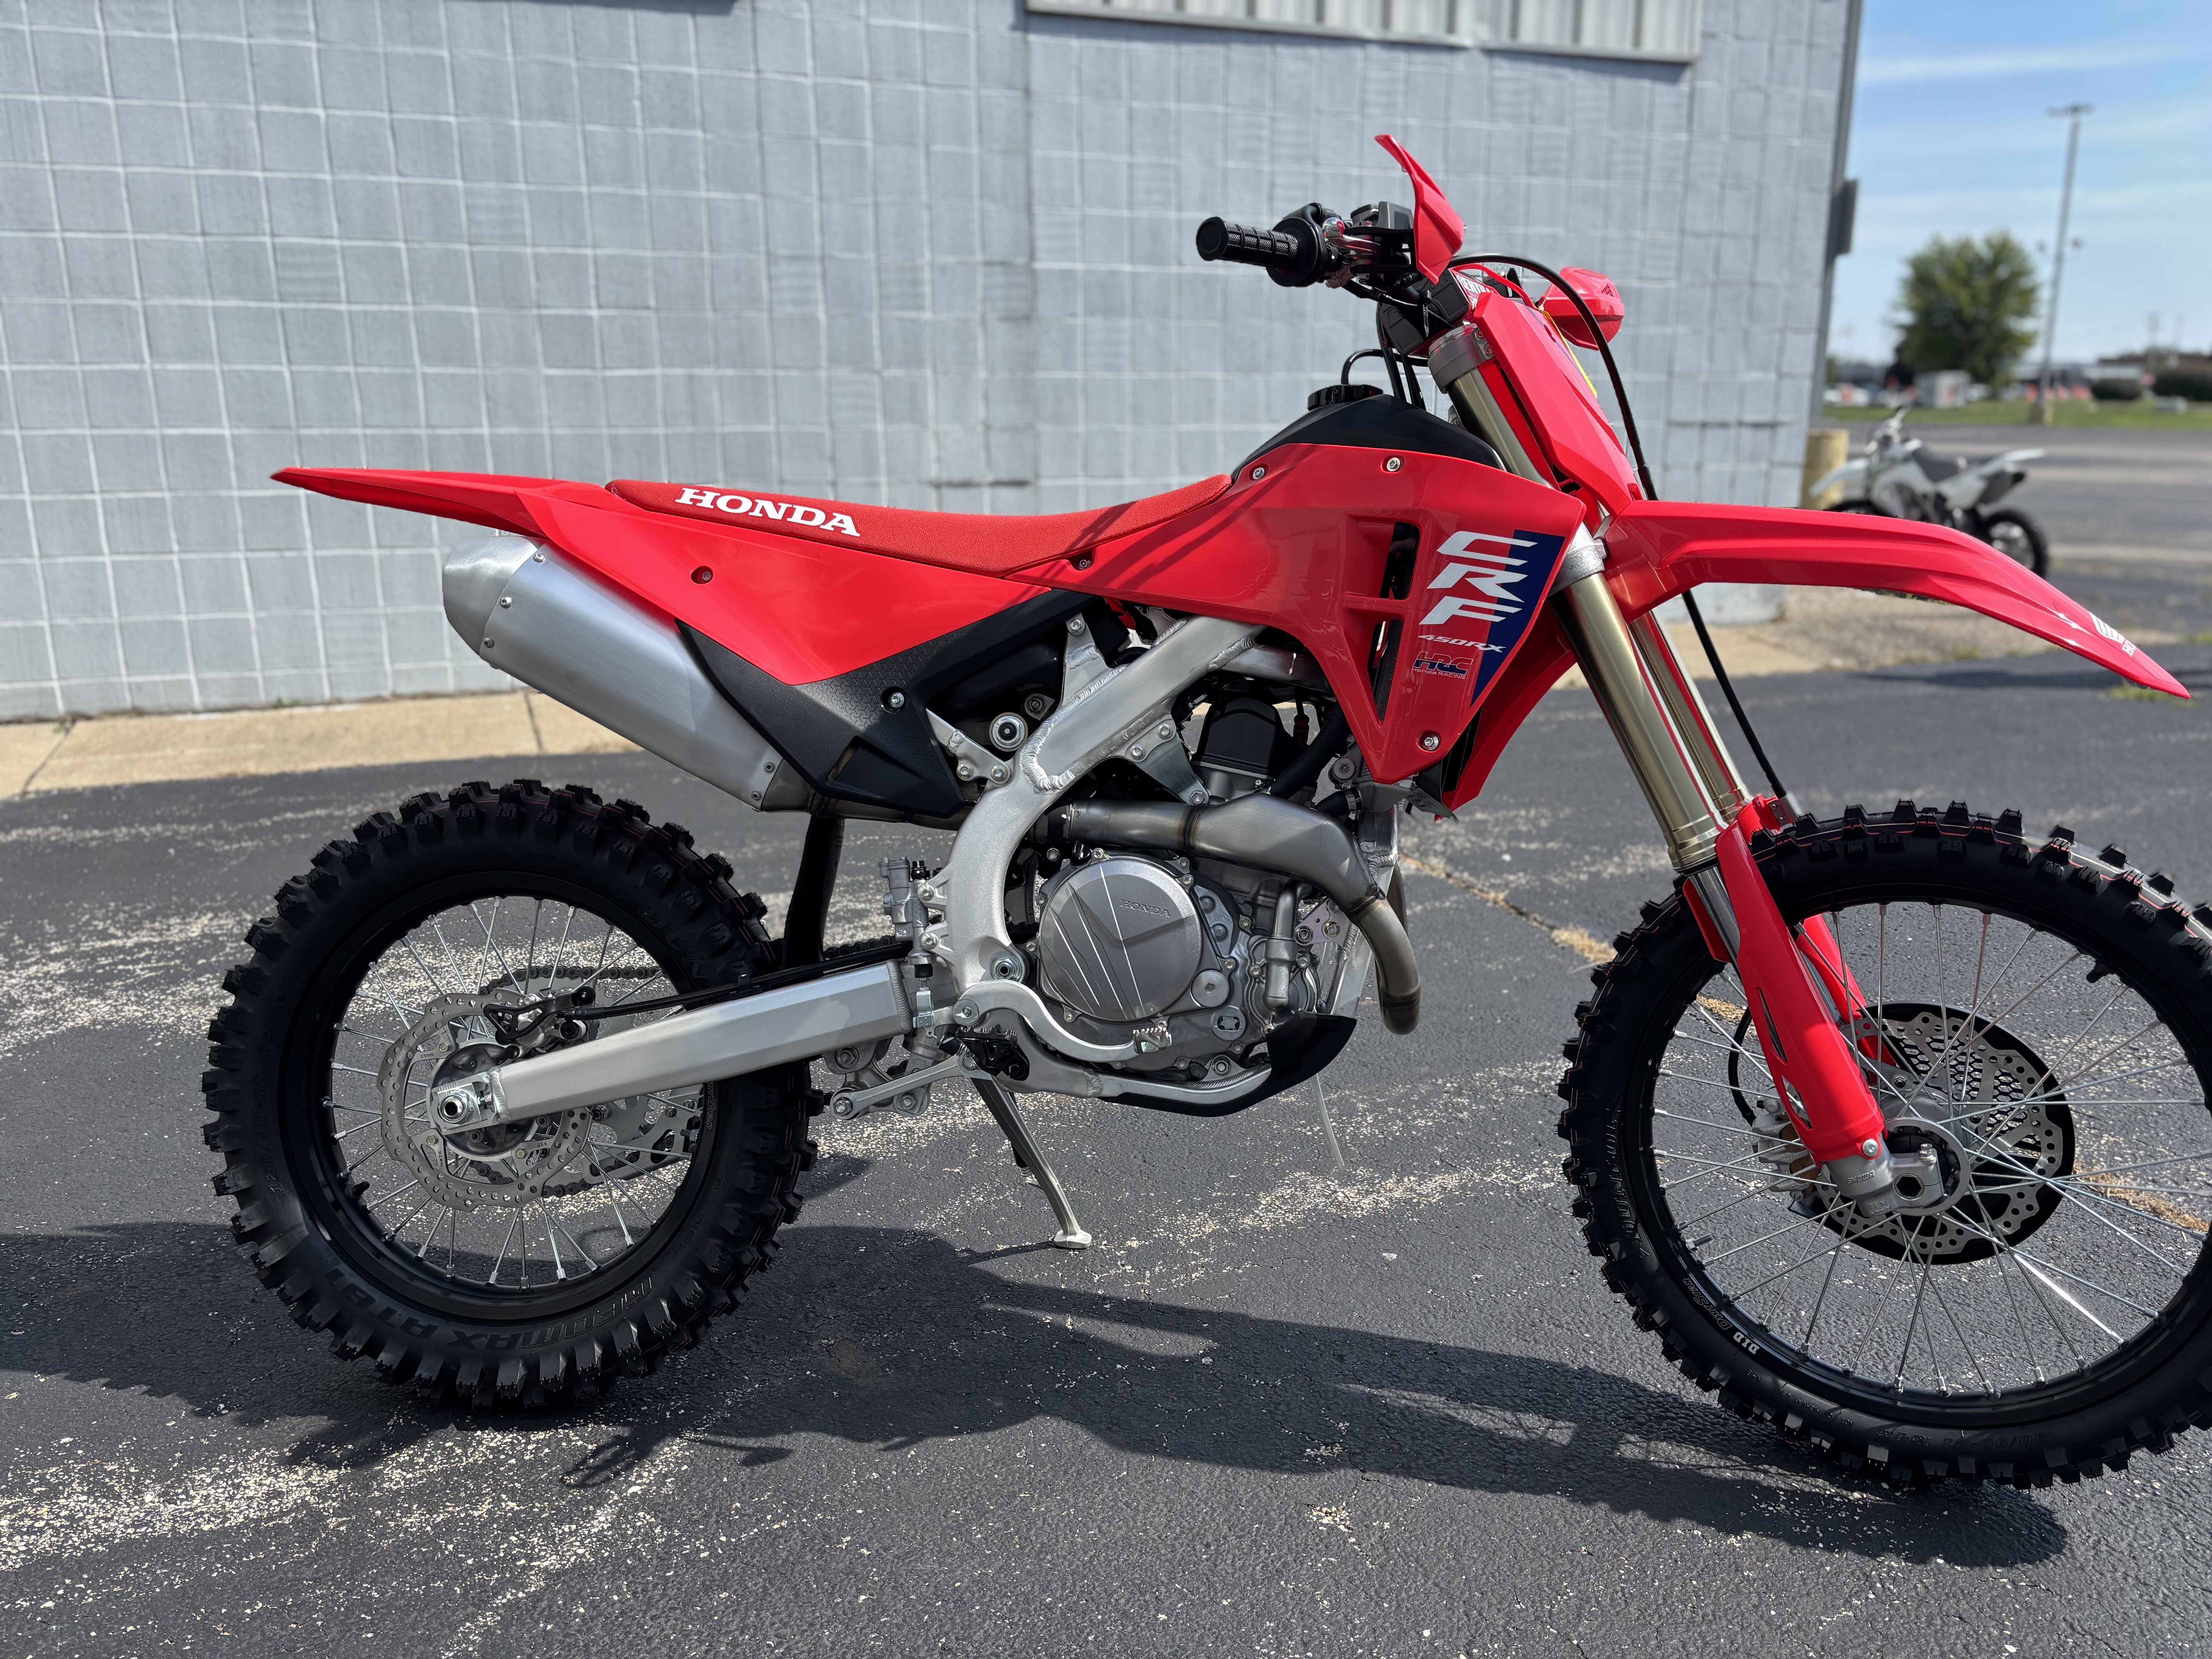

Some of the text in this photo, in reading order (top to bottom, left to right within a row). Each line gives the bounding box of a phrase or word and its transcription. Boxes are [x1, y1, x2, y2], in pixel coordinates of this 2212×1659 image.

[675, 488, 860, 537] HONDA
[1419, 531, 1538, 625] CRF
[1417, 635, 1507, 653] 450RX
[1412, 651, 1474, 676] HRC
[1119, 899, 1172, 918] HONDA
[1846, 1170, 1875, 1184] SHOWA
[324, 1267, 653, 1351] GEOMAX AT81
